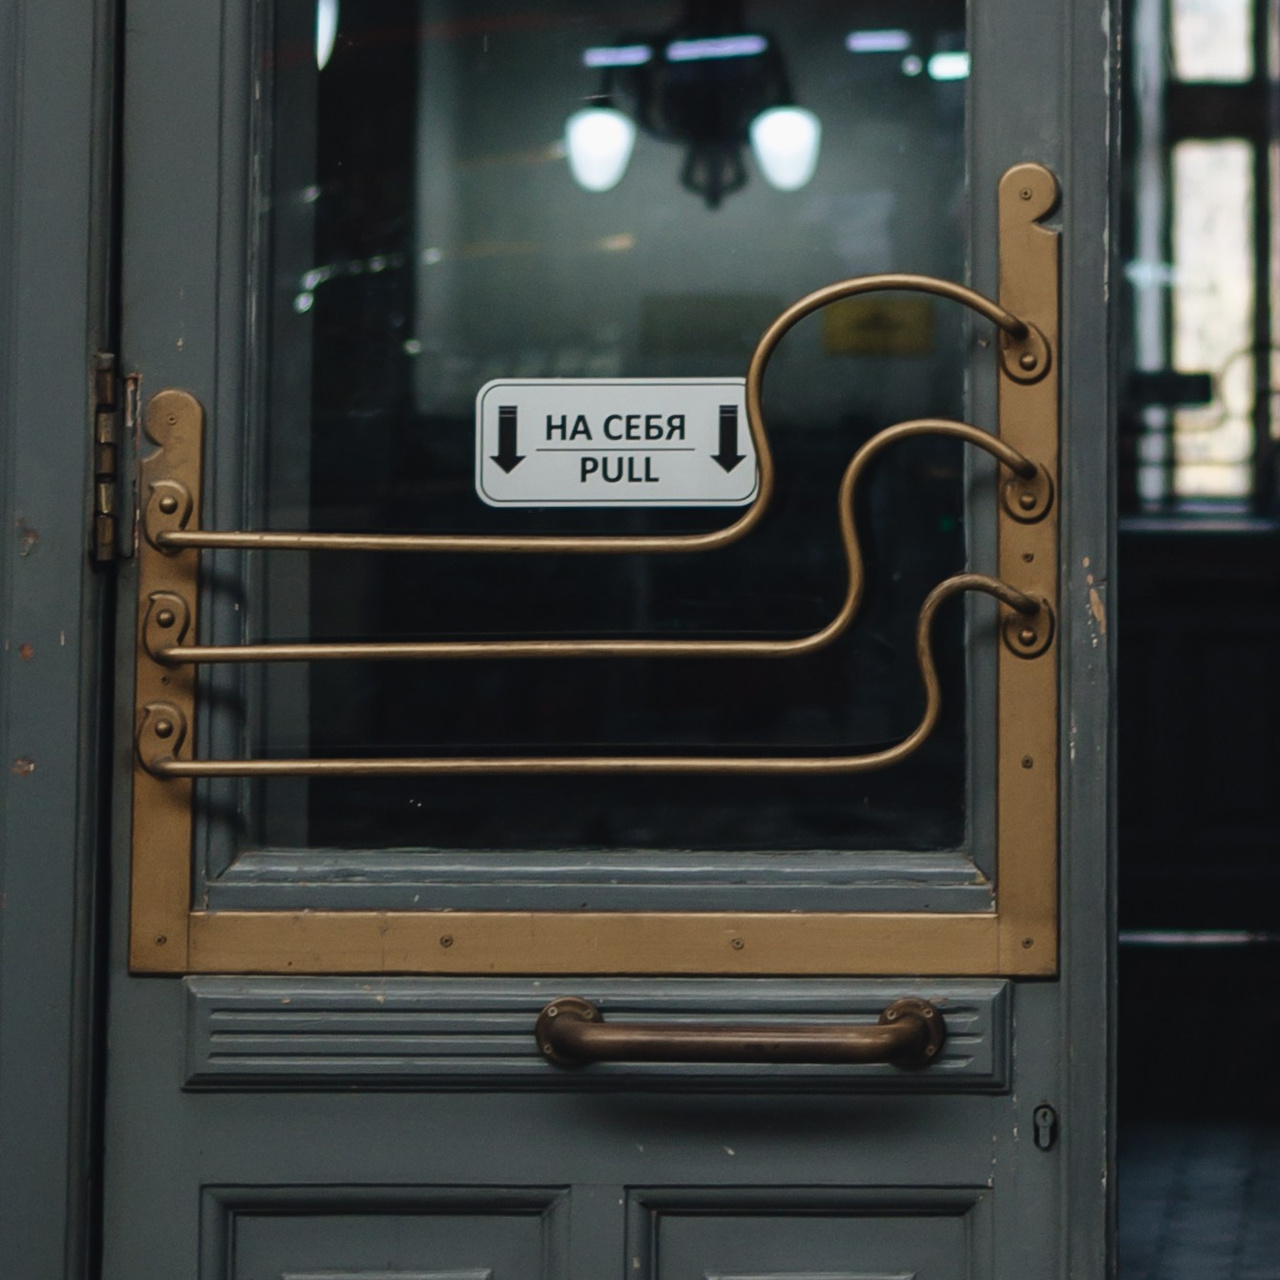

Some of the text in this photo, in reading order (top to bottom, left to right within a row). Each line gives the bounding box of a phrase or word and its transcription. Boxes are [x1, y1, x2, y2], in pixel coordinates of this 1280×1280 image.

[546, 414, 686, 441] НА СЕБЯ
[580, 456, 660, 483] PULL
